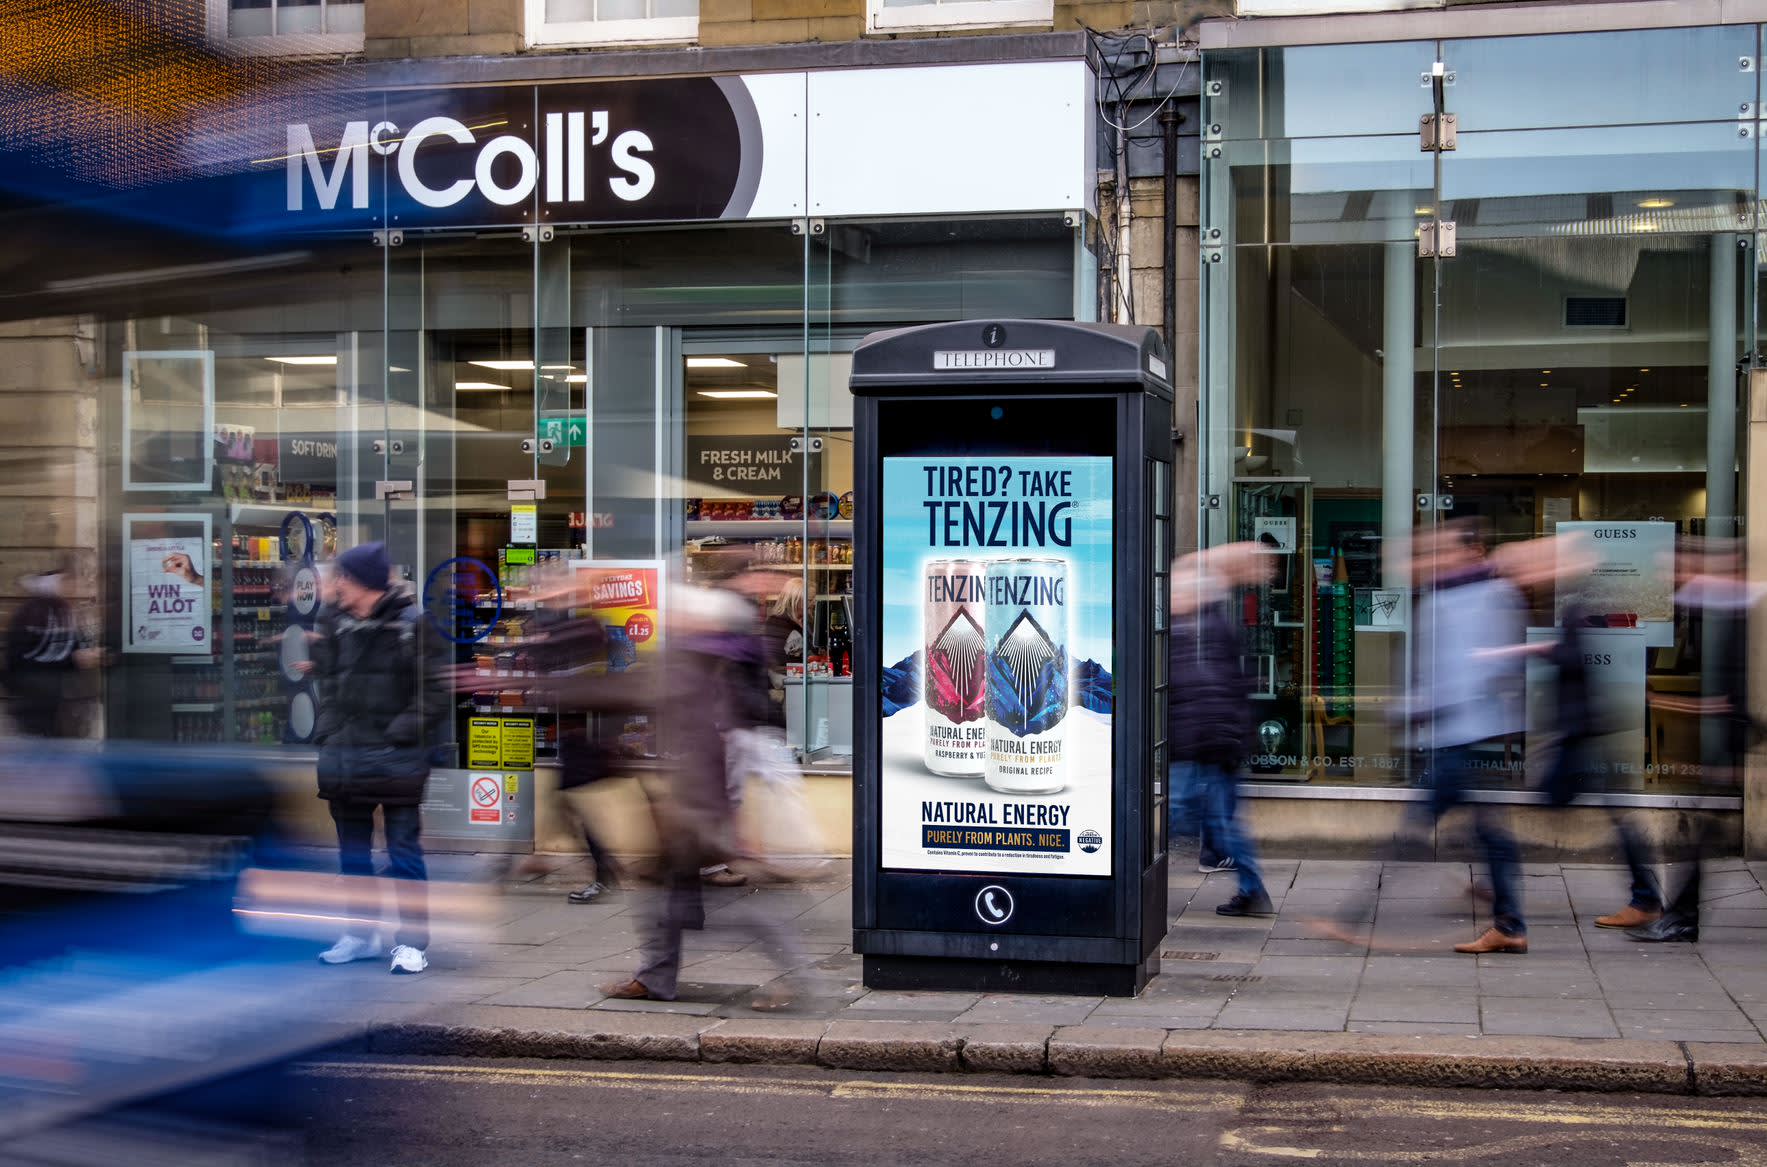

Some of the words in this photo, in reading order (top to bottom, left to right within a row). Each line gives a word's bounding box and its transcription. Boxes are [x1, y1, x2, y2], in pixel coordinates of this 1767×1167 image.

[287, 111, 656, 211] McColl's
[942, 351, 1047, 368] TELEPHONE
[291, 440, 315, 456] SOFT
[316, 442, 338, 458] DRIN
[700, 450, 752, 465] FRESH
[755, 450, 793, 464] MILK
[713, 467, 725, 480] &
[727, 467, 781, 480] CREAM
[923, 466, 1012, 497] TIRED?
[1018, 471, 1072, 497] TAKE
[1594, 529, 1637, 539] GUESS
[148, 584, 181, 598] WIN
[593, 580, 643, 601] SAVINGS
[928, 575, 986, 603] TENZIN
[988, 576, 1065, 607] TENZING
[148, 600, 161, 614] A
[163, 599, 196, 613] LOT
[629, 624, 649, 636] £1.25
[1584, 654, 1612, 665] ESS
[930, 726, 963, 740] NATURAL
[952, 739, 971, 748] FROM
[990, 738, 1027, 754] NATURAL
[1030, 740, 1063, 755] ENERGY
[935, 749, 968, 760] RASPBERRY
[1014, 753, 1036, 764] FROM
[1247, 755, 1297, 766] OBSON
[1301, 756, 1310, 766] &
[998, 765, 1029, 776] ORIGINAL
[1031, 766, 1054, 776] RECIPE
[1647, 763, 1677, 775] 0191
[922, 801, 998, 824] NATURAL
[1003, 804, 1071, 827] ENERGY
[927, 830, 963, 845] PURELY
[965, 831, 992, 846] FROM
[995, 832, 1035, 847] PLANTS.
[1039, 833, 1065, 848] NICE.
